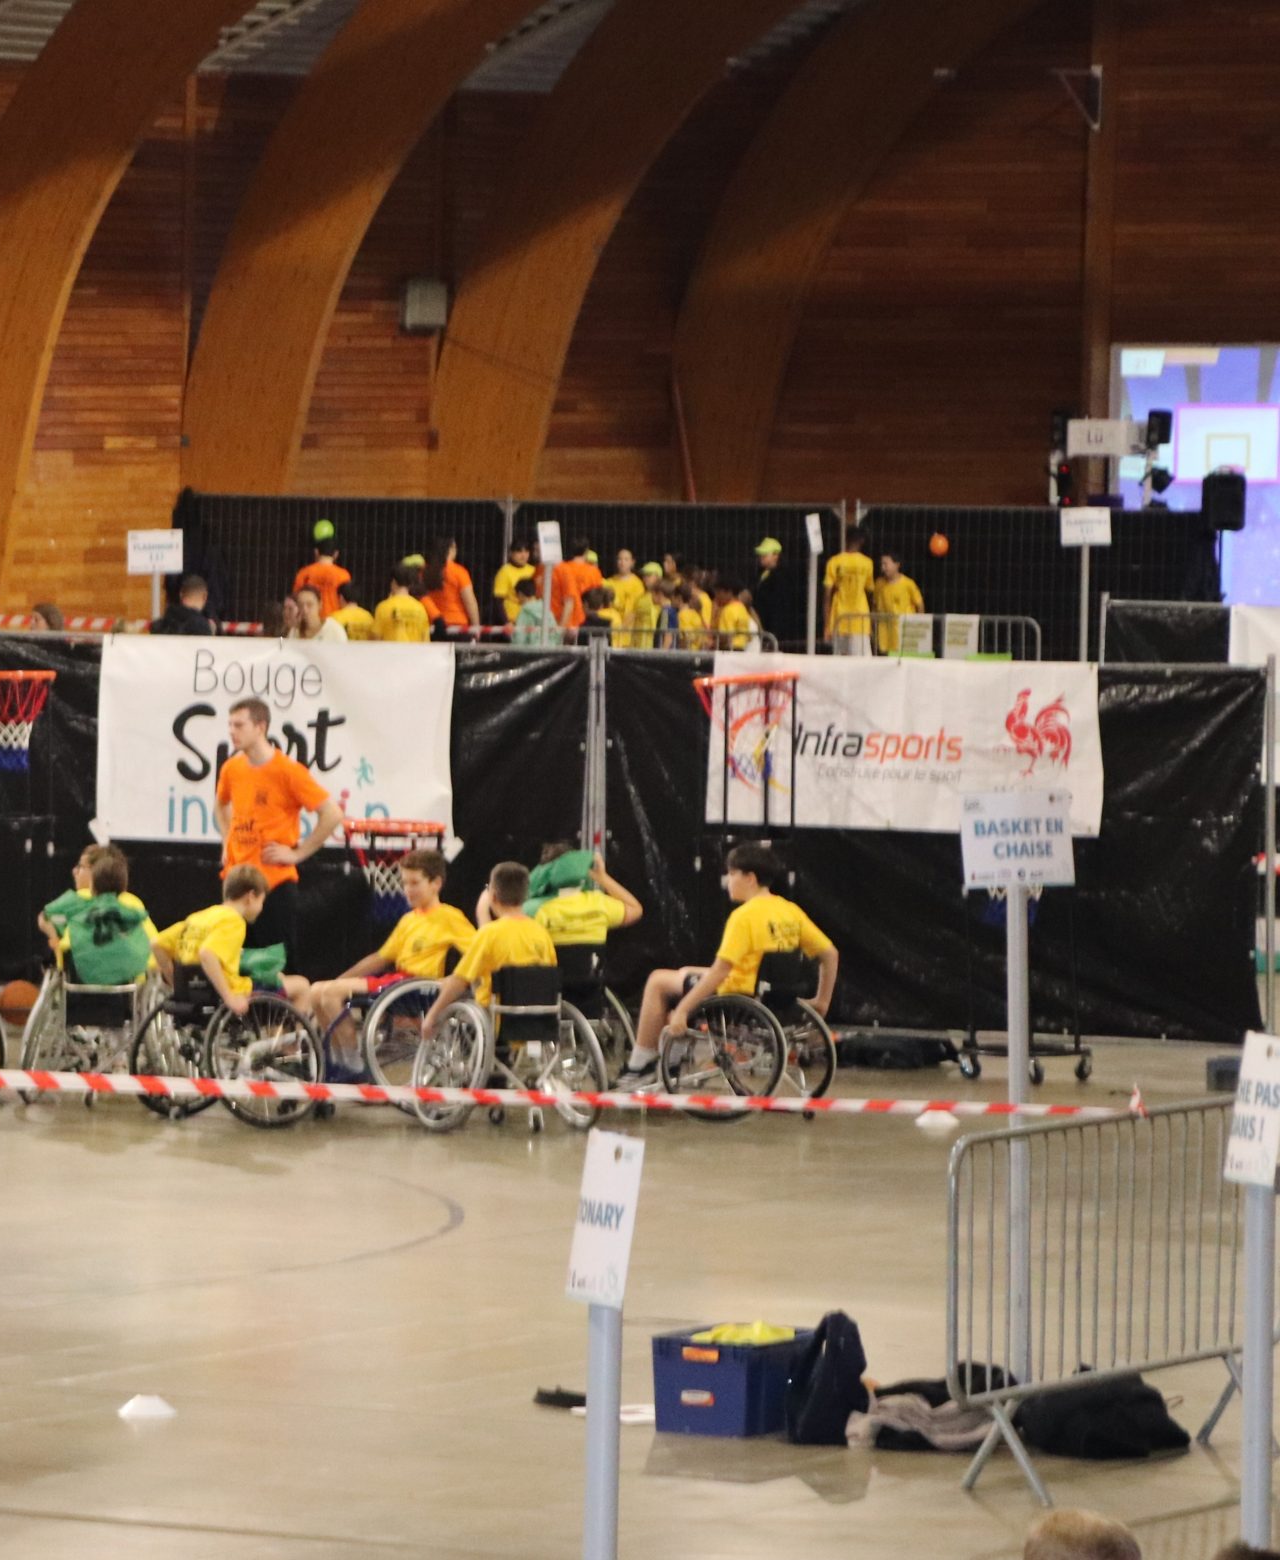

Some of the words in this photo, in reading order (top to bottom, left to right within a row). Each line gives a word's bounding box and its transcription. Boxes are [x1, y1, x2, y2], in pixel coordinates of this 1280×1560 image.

[193, 648, 323, 709] Bouge
[172, 703, 346, 794] Sprt
[794, 721, 964, 764] Infrasports
[929, 769, 962, 784] sport
[974, 818, 1041, 836] BASKET
[1045, 817, 1064, 833] EN
[993, 840, 1054, 860] CHAISE
[1254, 1080, 1280, 1109] PAS
